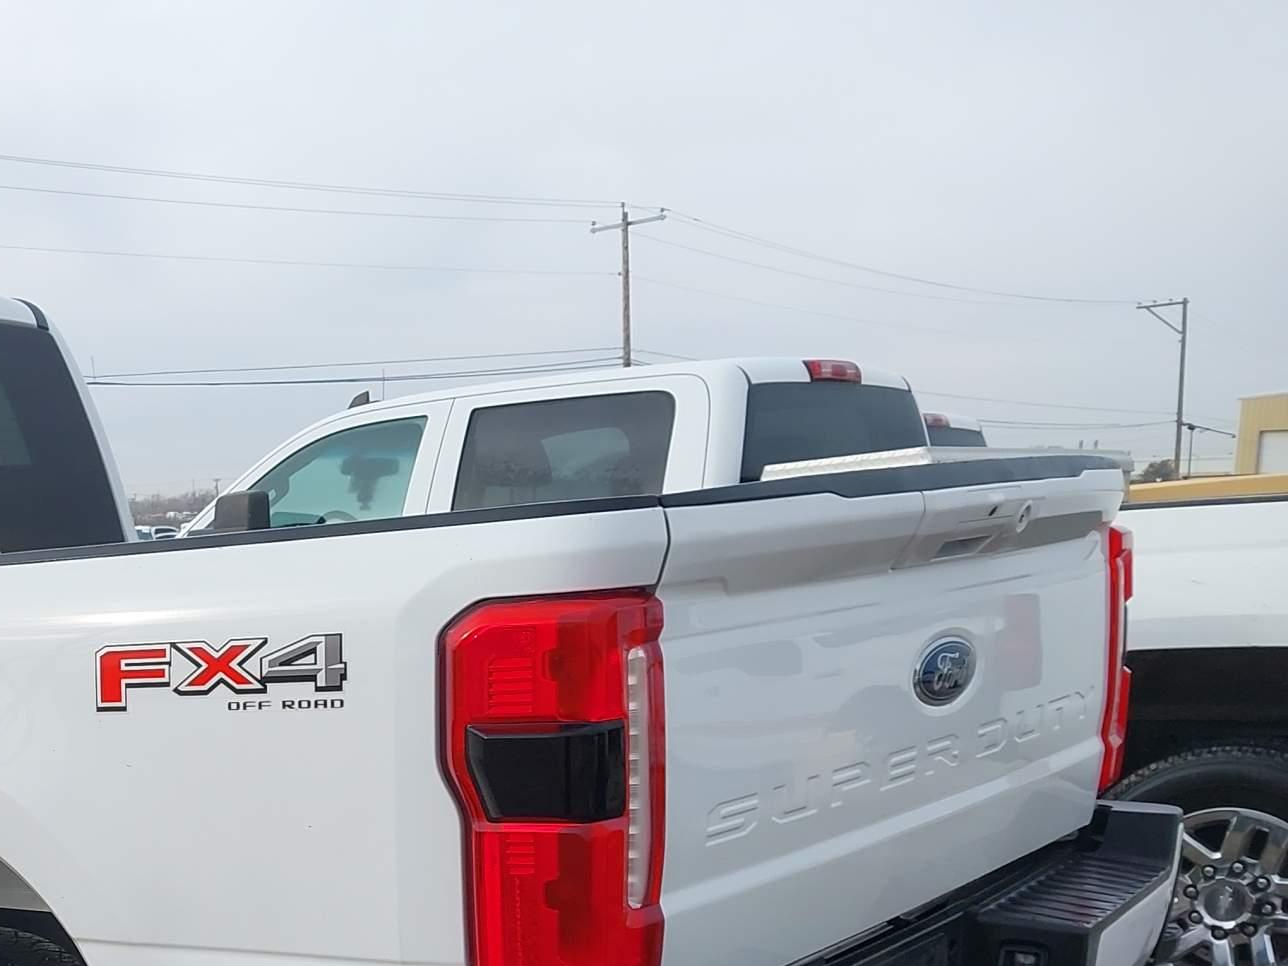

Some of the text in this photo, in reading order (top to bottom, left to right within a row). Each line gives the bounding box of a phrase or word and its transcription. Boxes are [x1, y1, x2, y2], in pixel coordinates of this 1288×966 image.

[95, 633, 347, 712] FX4
[227, 698, 345, 711] OFF ROAD
[705, 685, 1096, 847] SUPER DUTY
